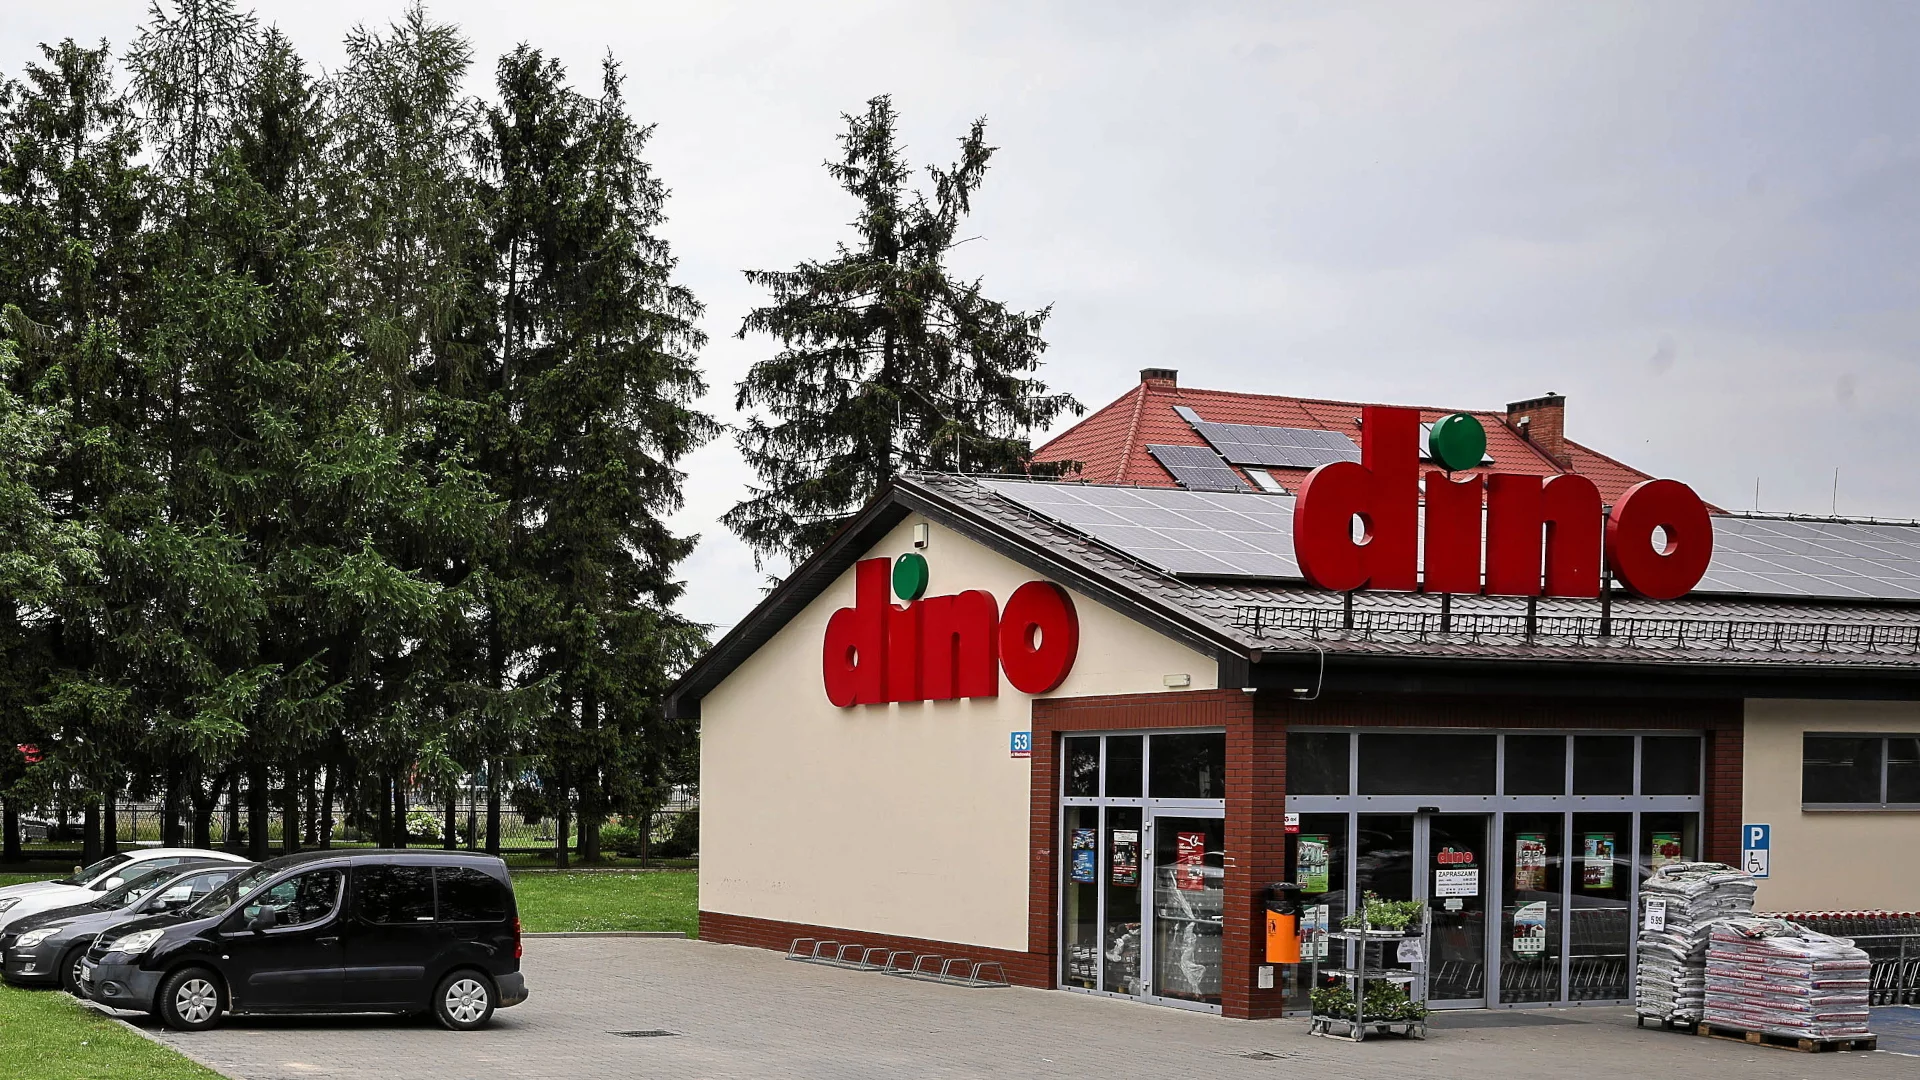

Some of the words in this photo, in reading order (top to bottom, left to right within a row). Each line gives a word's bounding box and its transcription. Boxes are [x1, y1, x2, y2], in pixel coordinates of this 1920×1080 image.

[1293, 406, 1713, 600] dino
[823, 553, 1080, 708] dino
[1014, 733, 1028, 750] 53
[1750, 826, 1764, 848] P
[1437, 847, 1473, 864] dino
